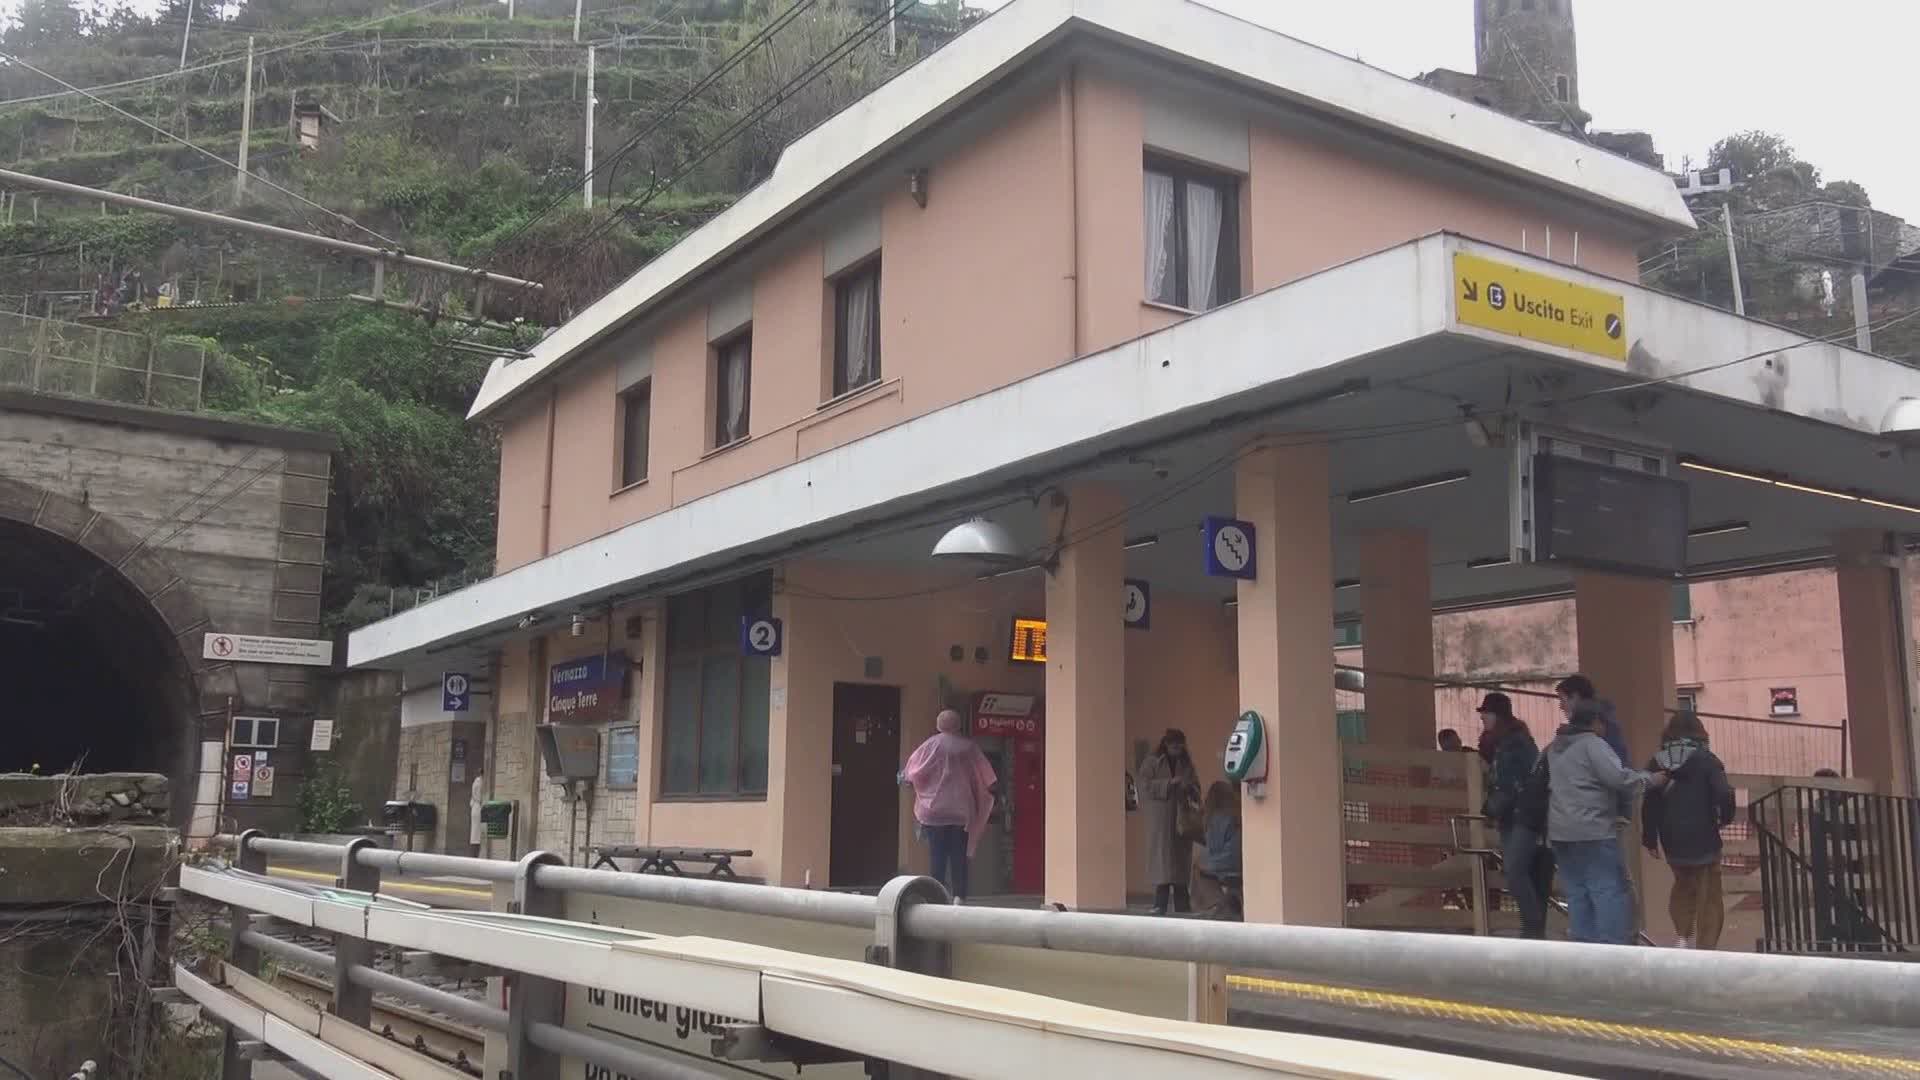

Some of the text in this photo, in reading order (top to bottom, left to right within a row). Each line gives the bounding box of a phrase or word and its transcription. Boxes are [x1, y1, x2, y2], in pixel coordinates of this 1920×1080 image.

[1513, 292, 1593, 329] Uscita Exit
[756, 626, 770, 646] 2
[551, 691, 598, 713] Cinque Terre
